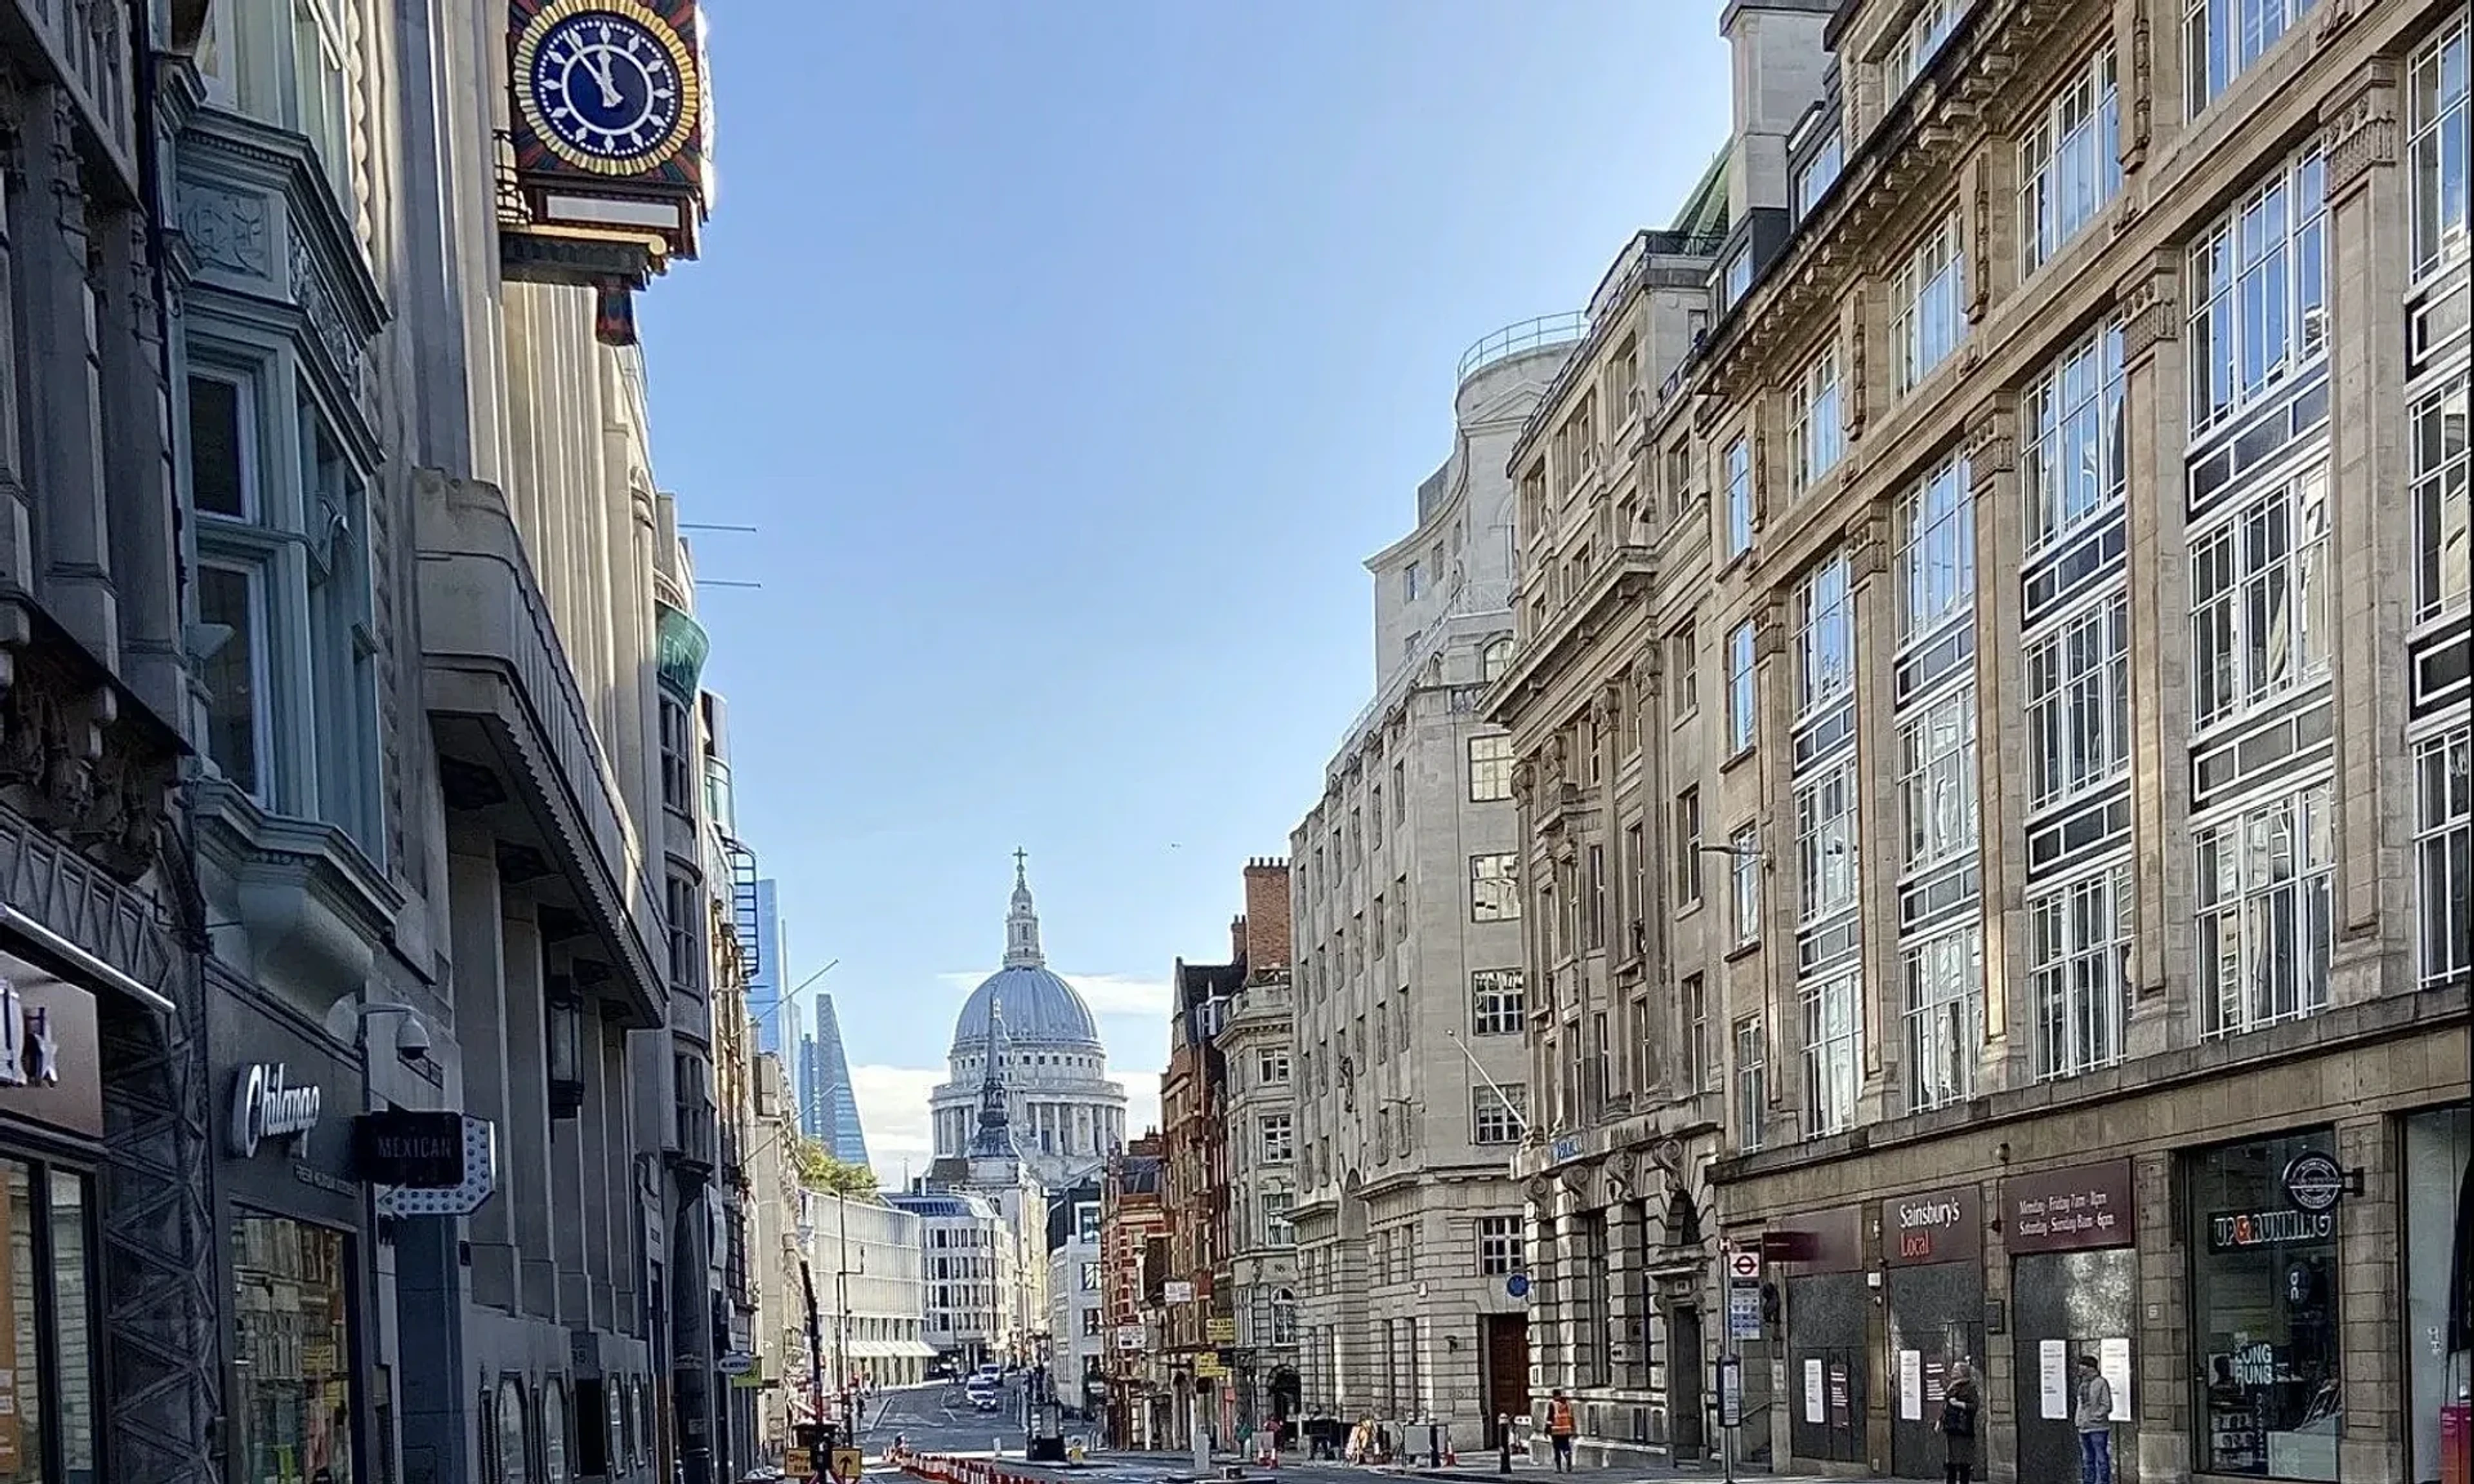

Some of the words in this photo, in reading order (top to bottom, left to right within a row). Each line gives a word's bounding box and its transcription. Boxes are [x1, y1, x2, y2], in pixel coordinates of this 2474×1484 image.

[378, 1137, 452, 1157] MEXICAN
[1899, 1197, 1960, 1228] Sainsbury's
[1900, 1230, 1929, 1257] Local
[2234, 1365, 2272, 1384] RUNS
